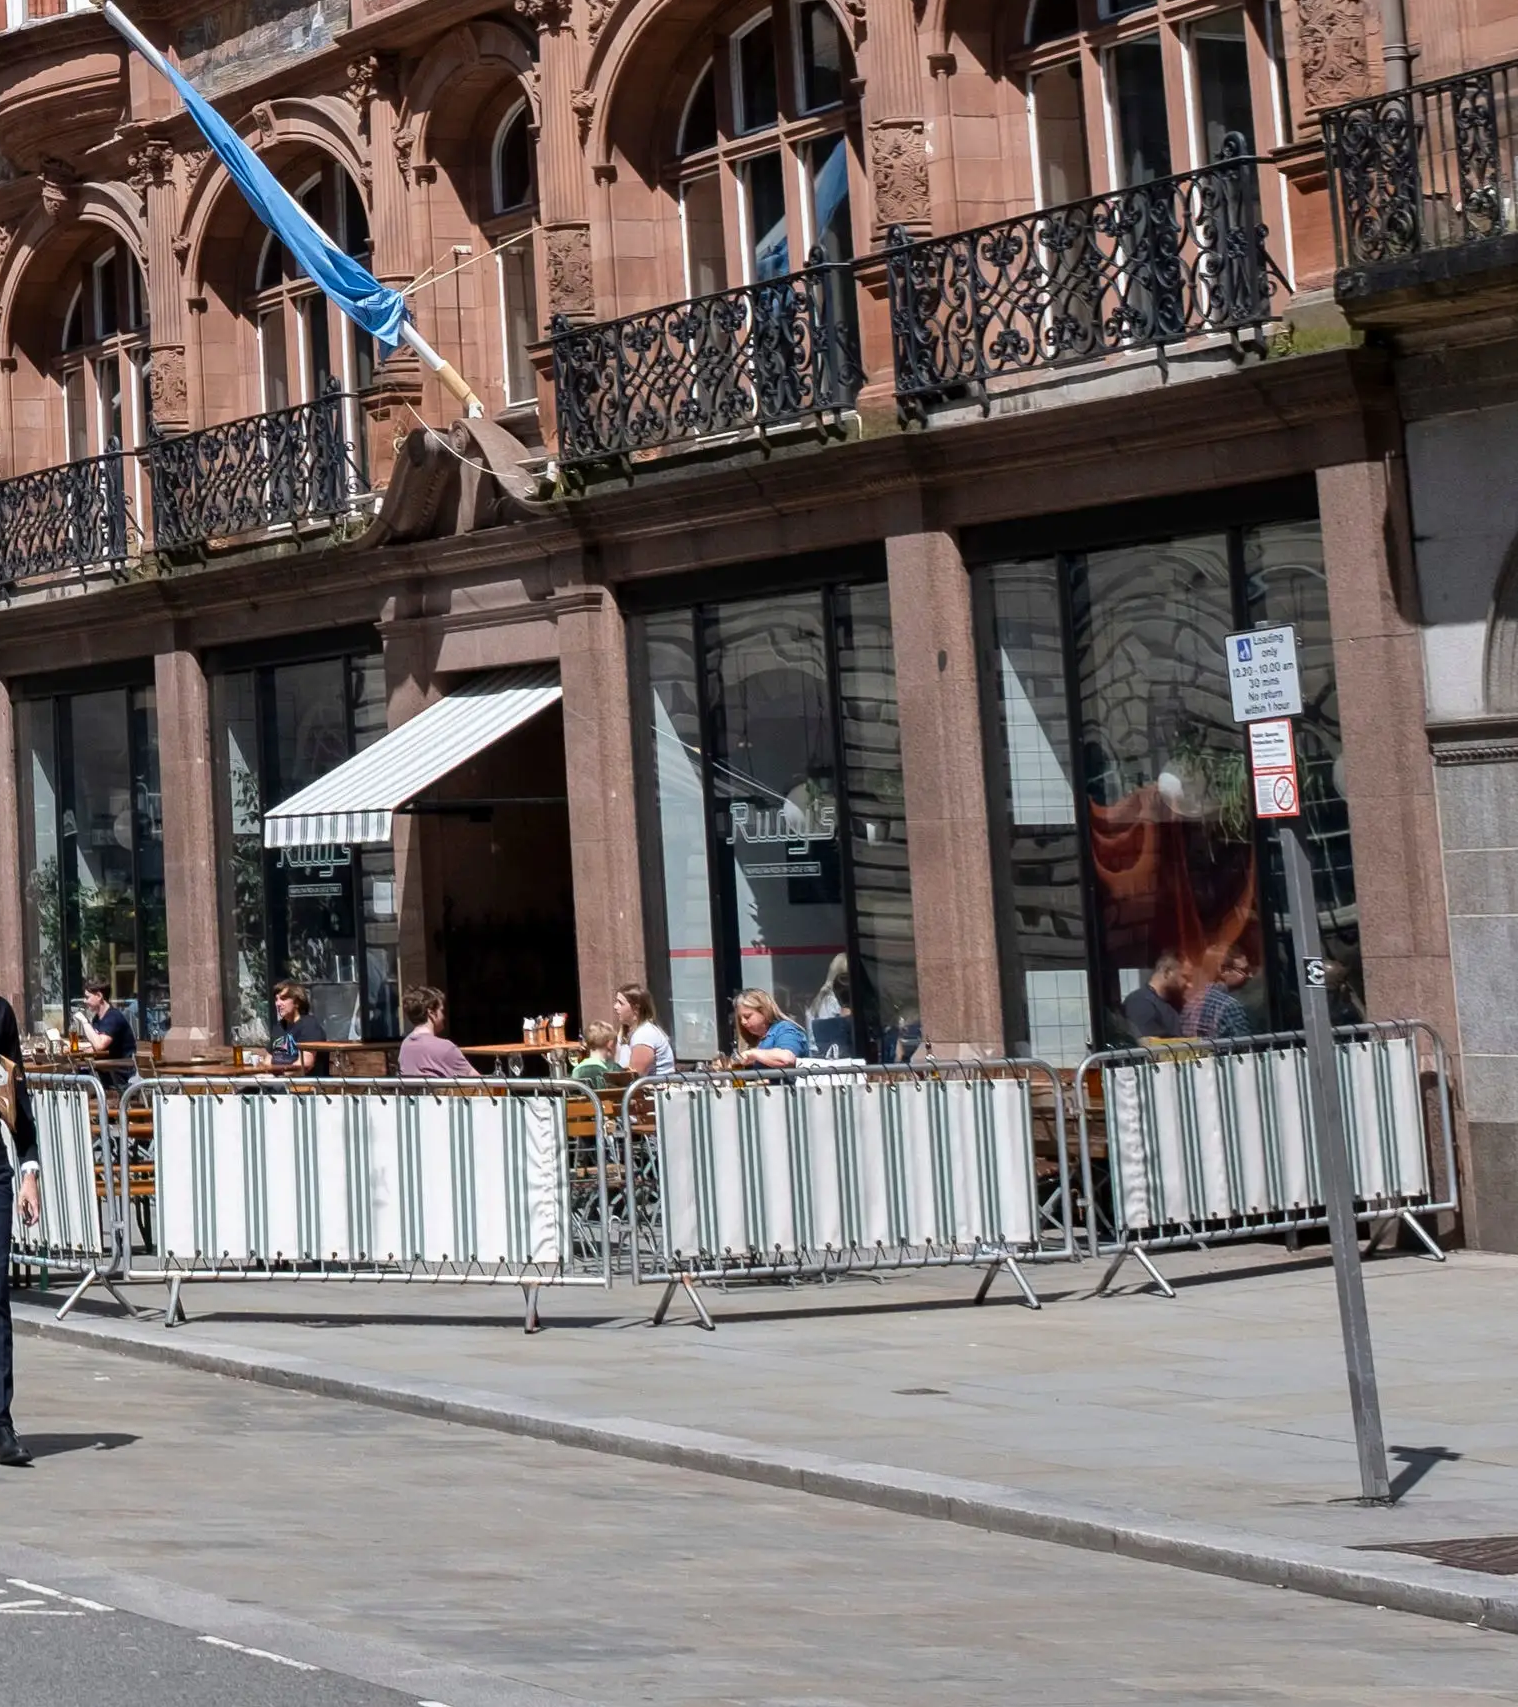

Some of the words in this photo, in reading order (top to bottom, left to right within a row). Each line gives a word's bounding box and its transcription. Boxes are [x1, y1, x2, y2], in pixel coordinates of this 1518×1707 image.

[1252, 633, 1284, 645] Loading
[1261, 646, 1278, 658] only
[1248, 678, 1261, 689] 30
[1262, 677, 1280, 686] mins
[1248, 692, 1259, 701] No
[1261, 690, 1284, 700] return
[1244, 704, 1266, 715] within
[1273, 701, 1291, 711] hour
